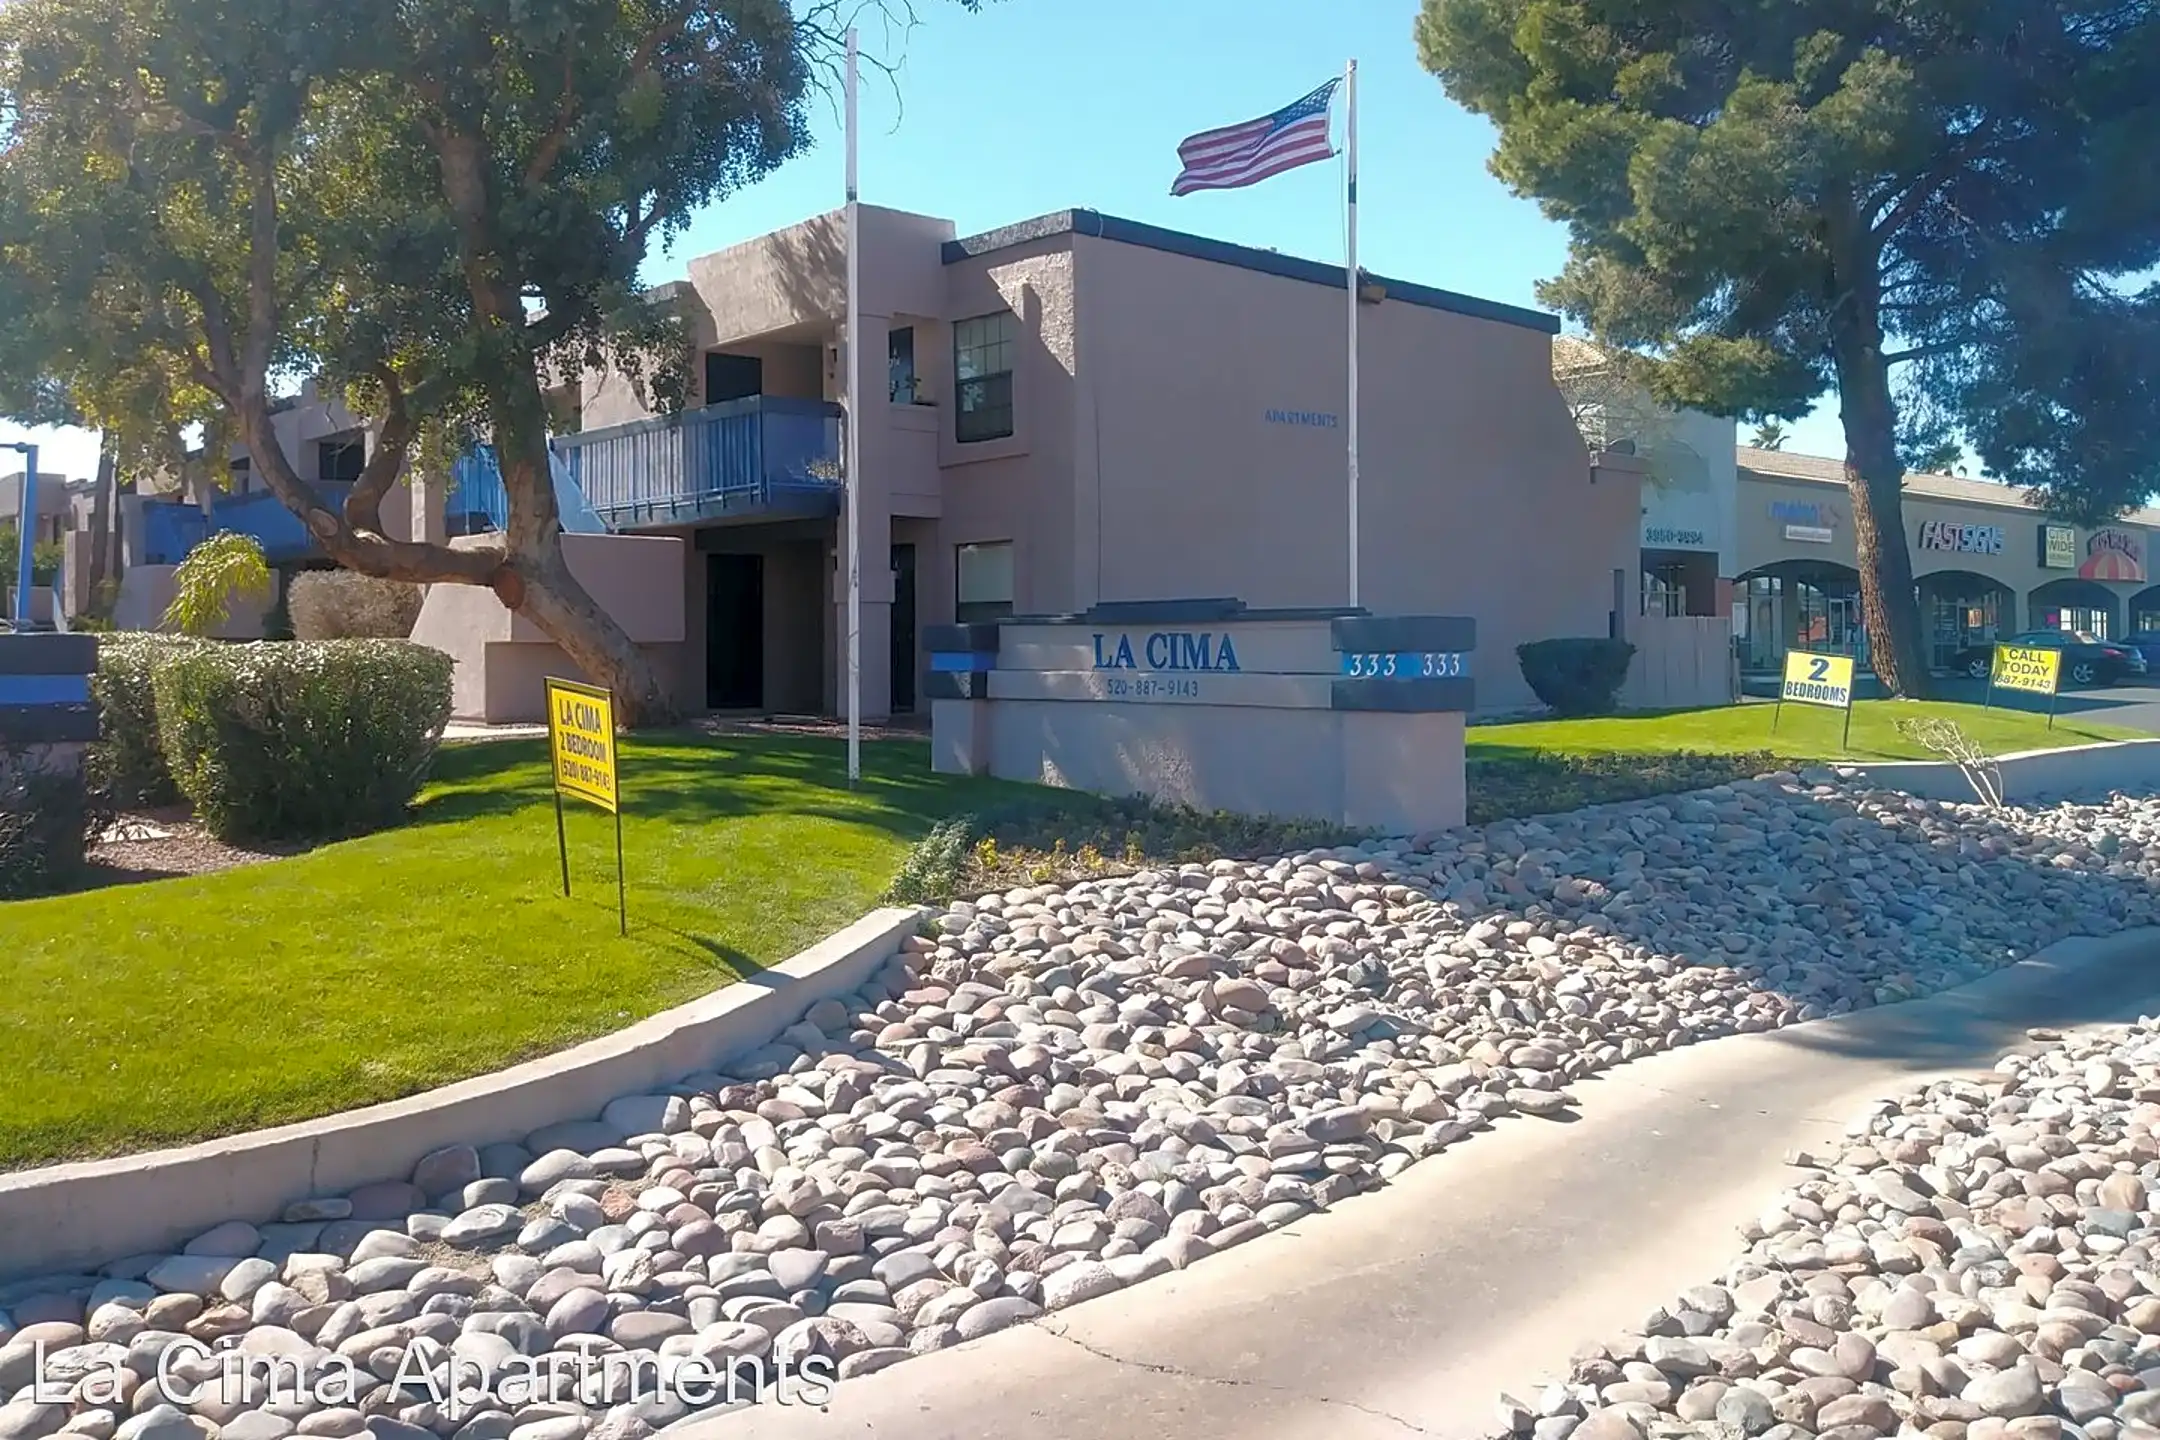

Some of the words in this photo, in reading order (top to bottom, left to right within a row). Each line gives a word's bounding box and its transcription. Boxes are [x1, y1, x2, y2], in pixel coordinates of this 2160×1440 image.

[1264, 408, 1337, 428] APARTMENTS
[2048, 528, 2073, 541] CITY
[2048, 540, 2075, 553] WIDE
[1093, 633, 1137, 669] LA
[1146, 632, 1240, 671] CIMA
[2009, 648, 2045, 664] CALL
[1350, 653, 1396, 676] 333
[1423, 653, 1460, 676] 333
[1808, 658, 1830, 682] 2
[2002, 660, 2050, 677] TODAY
[1107, 678, 1198, 697] 520-887-9143
[1785, 680, 1847, 702] BEDROOMS
[559, 698, 573, 726] LA
[575, 702, 602, 735] CIMA
[559, 731, 565, 751] 2
[566, 733, 607, 764] BEDROOM
